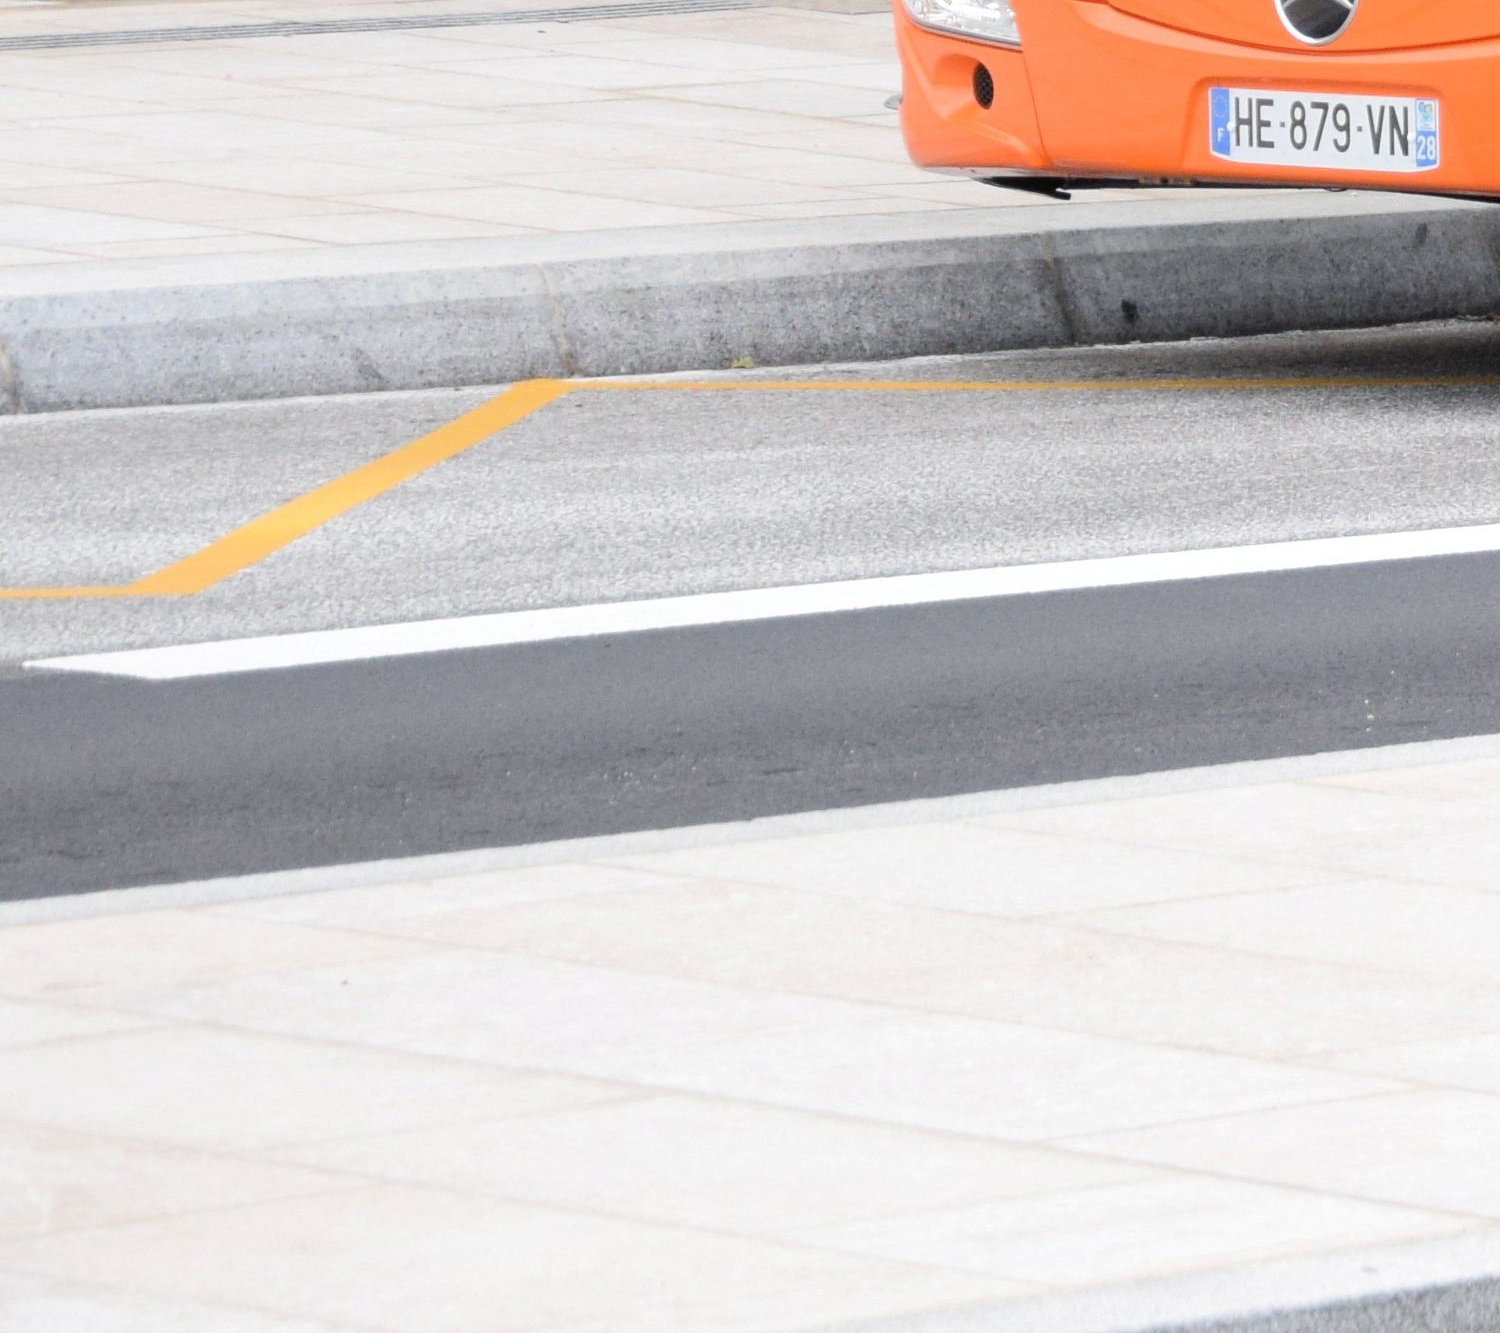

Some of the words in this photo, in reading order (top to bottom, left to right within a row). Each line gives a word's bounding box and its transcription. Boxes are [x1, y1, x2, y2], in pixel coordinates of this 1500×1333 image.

[1216, 127, 1225, 142] F
[1234, 96, 1410, 157] HE-879-VN
[1416, 135, 1437, 161] 28
